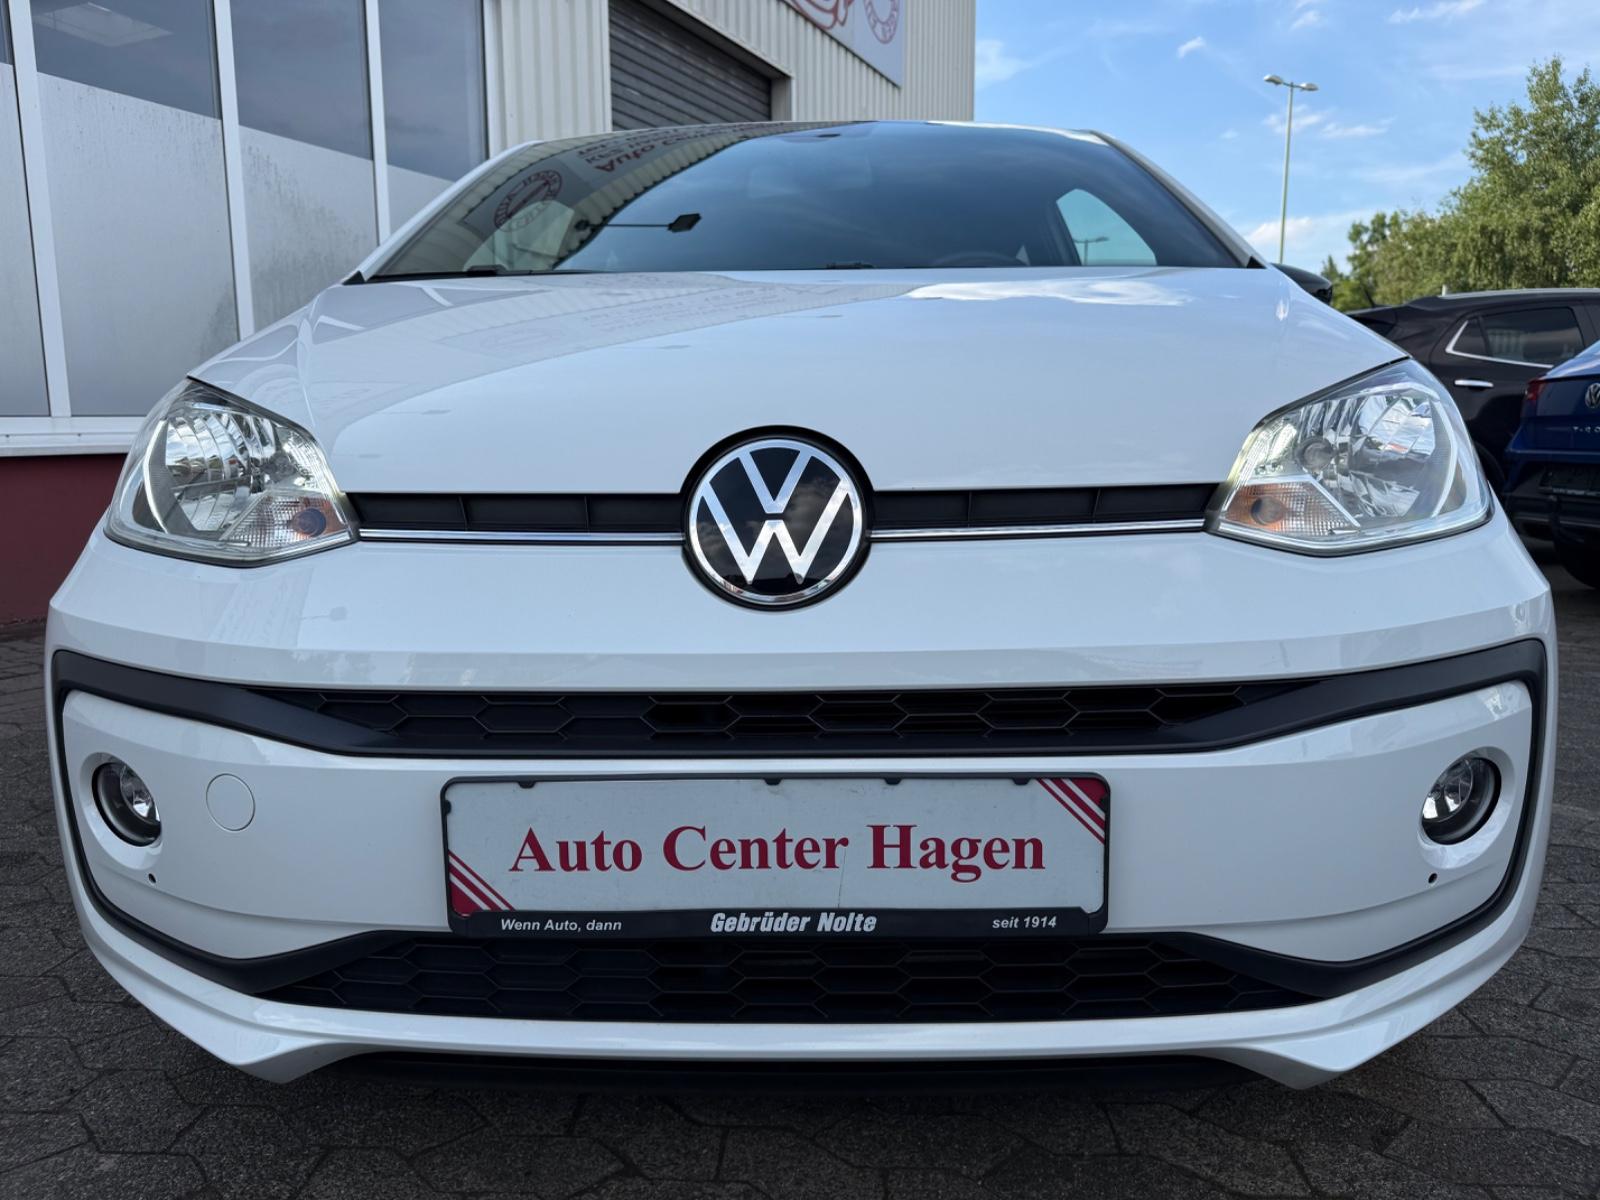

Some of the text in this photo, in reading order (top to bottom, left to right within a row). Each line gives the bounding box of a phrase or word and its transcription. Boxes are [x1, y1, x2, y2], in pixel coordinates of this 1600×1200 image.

[695, 443, 858, 590] VW
[508, 824, 1046, 882] Auto Center Hagen
[500, 918, 622, 934] Wenn Auto, dann
[710, 912, 878, 933] Gebrüder Nolte
[992, 916, 1057, 929] seit 1914
